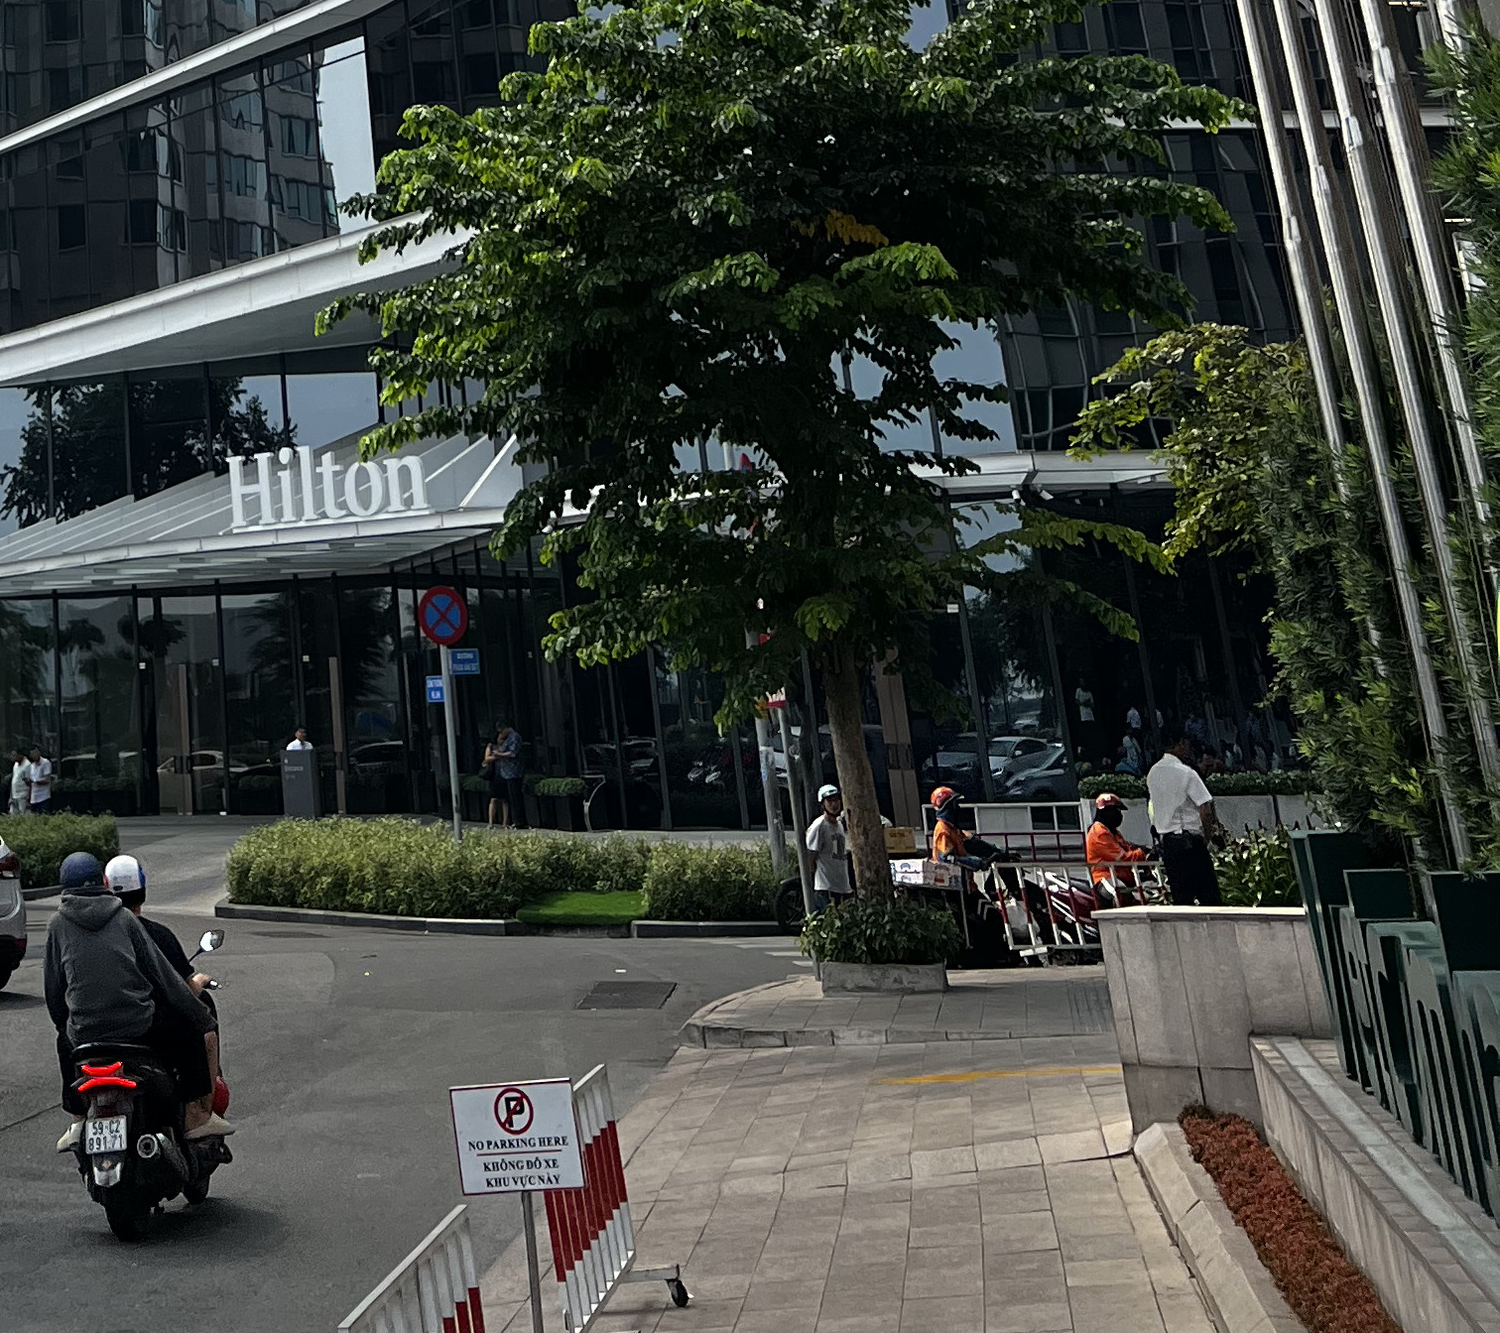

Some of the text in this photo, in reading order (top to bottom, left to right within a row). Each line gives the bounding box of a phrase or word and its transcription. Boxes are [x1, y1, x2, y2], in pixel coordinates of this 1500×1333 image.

[227, 445, 432, 528] Hilton
[468, 1135, 569, 1151] NO PARKING HERE
[483, 1158, 525, 1172] KHÔNG
[543, 1158, 560, 1169] XE
[485, 1172, 561, 1189] KHU VỰC NÀY
